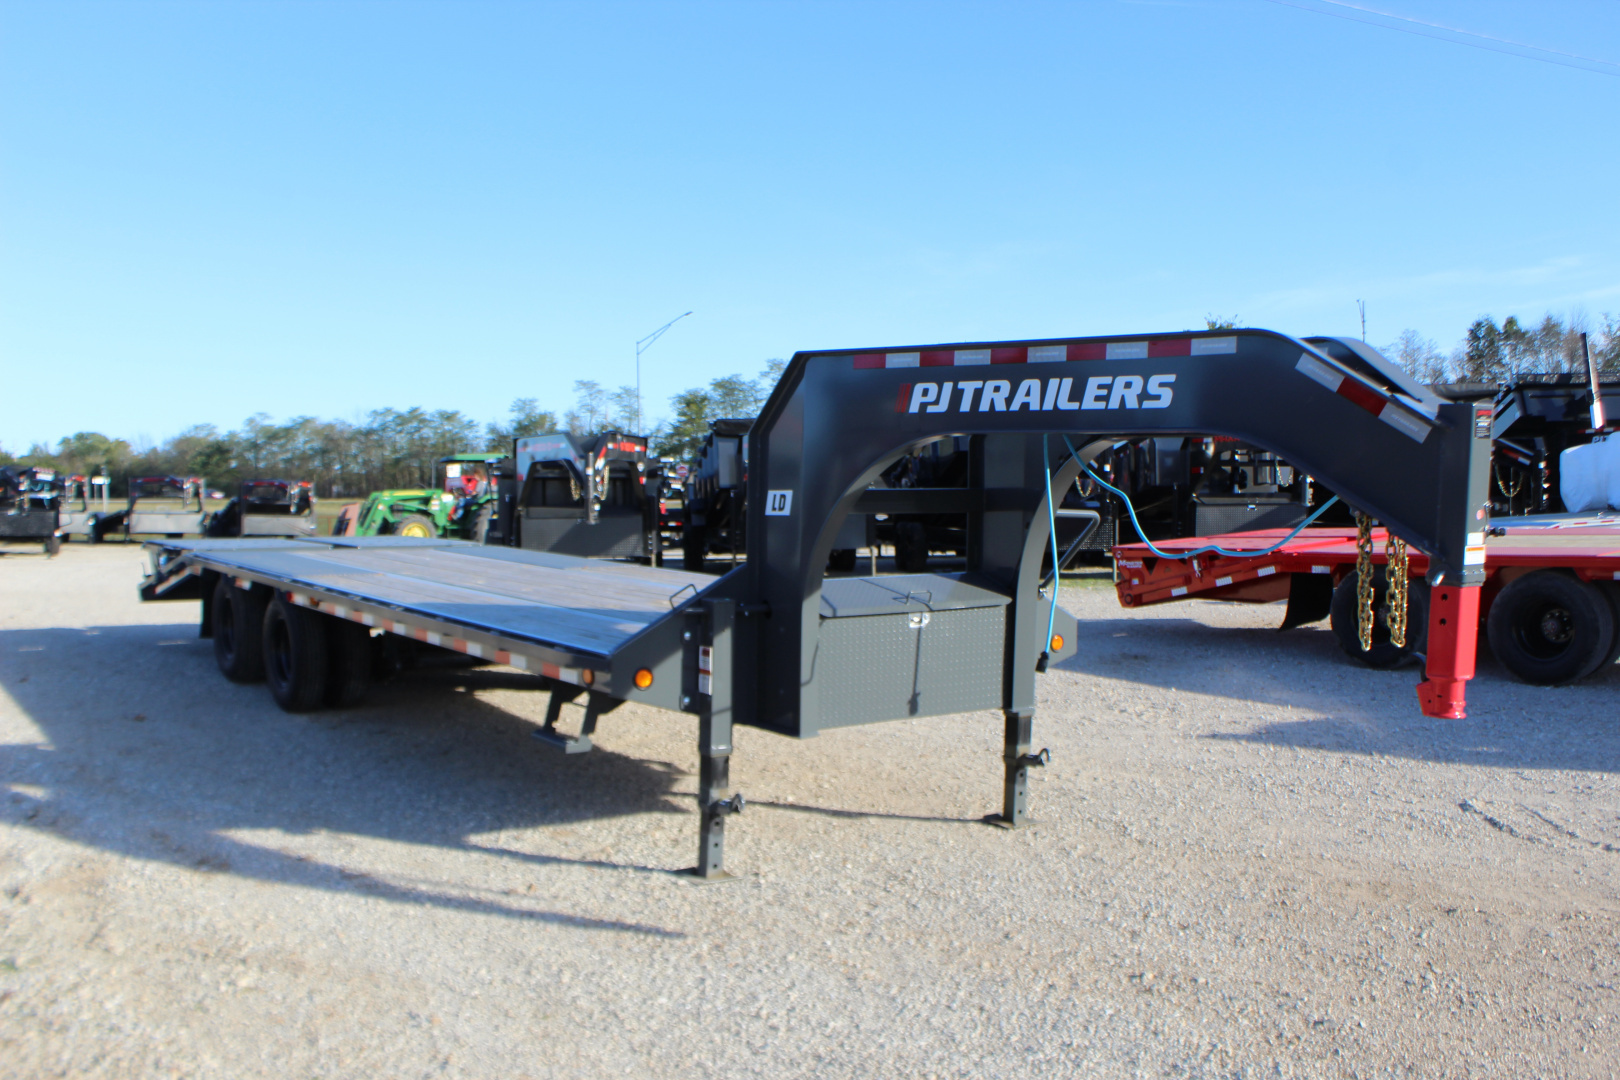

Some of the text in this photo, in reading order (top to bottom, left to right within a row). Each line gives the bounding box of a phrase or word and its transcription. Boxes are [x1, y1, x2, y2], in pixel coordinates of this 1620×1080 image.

[908, 374, 1177, 414] PJ TRAILERS
[771, 493, 787, 512] LD
